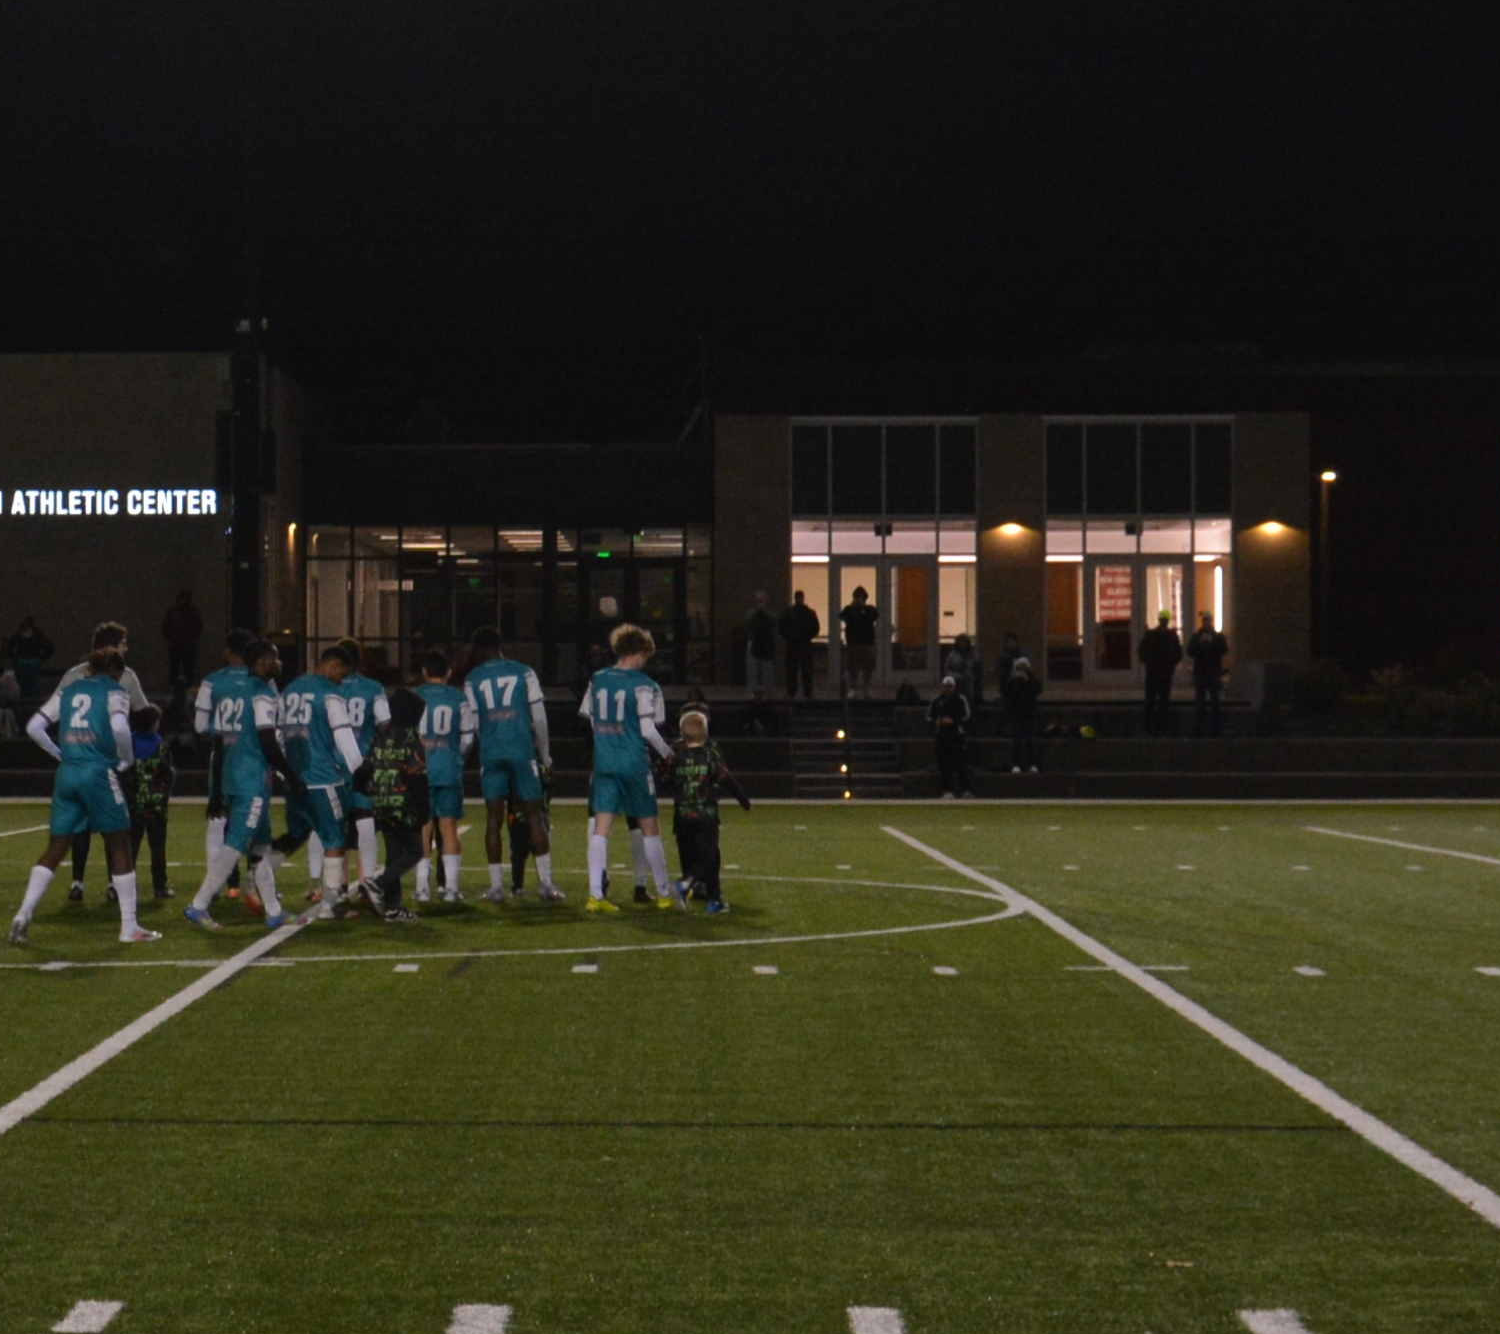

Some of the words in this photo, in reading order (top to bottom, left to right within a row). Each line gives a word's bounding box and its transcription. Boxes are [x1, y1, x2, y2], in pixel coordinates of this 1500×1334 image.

[10, 489, 119, 515] ATHLETIC
[126, 489, 217, 515] CENTER
[285, 692, 314, 725] 25
[479, 675, 517, 709] 17
[596, 688, 626, 722] 11
[71, 693, 91, 728] 2
[220, 697, 245, 732] 22
